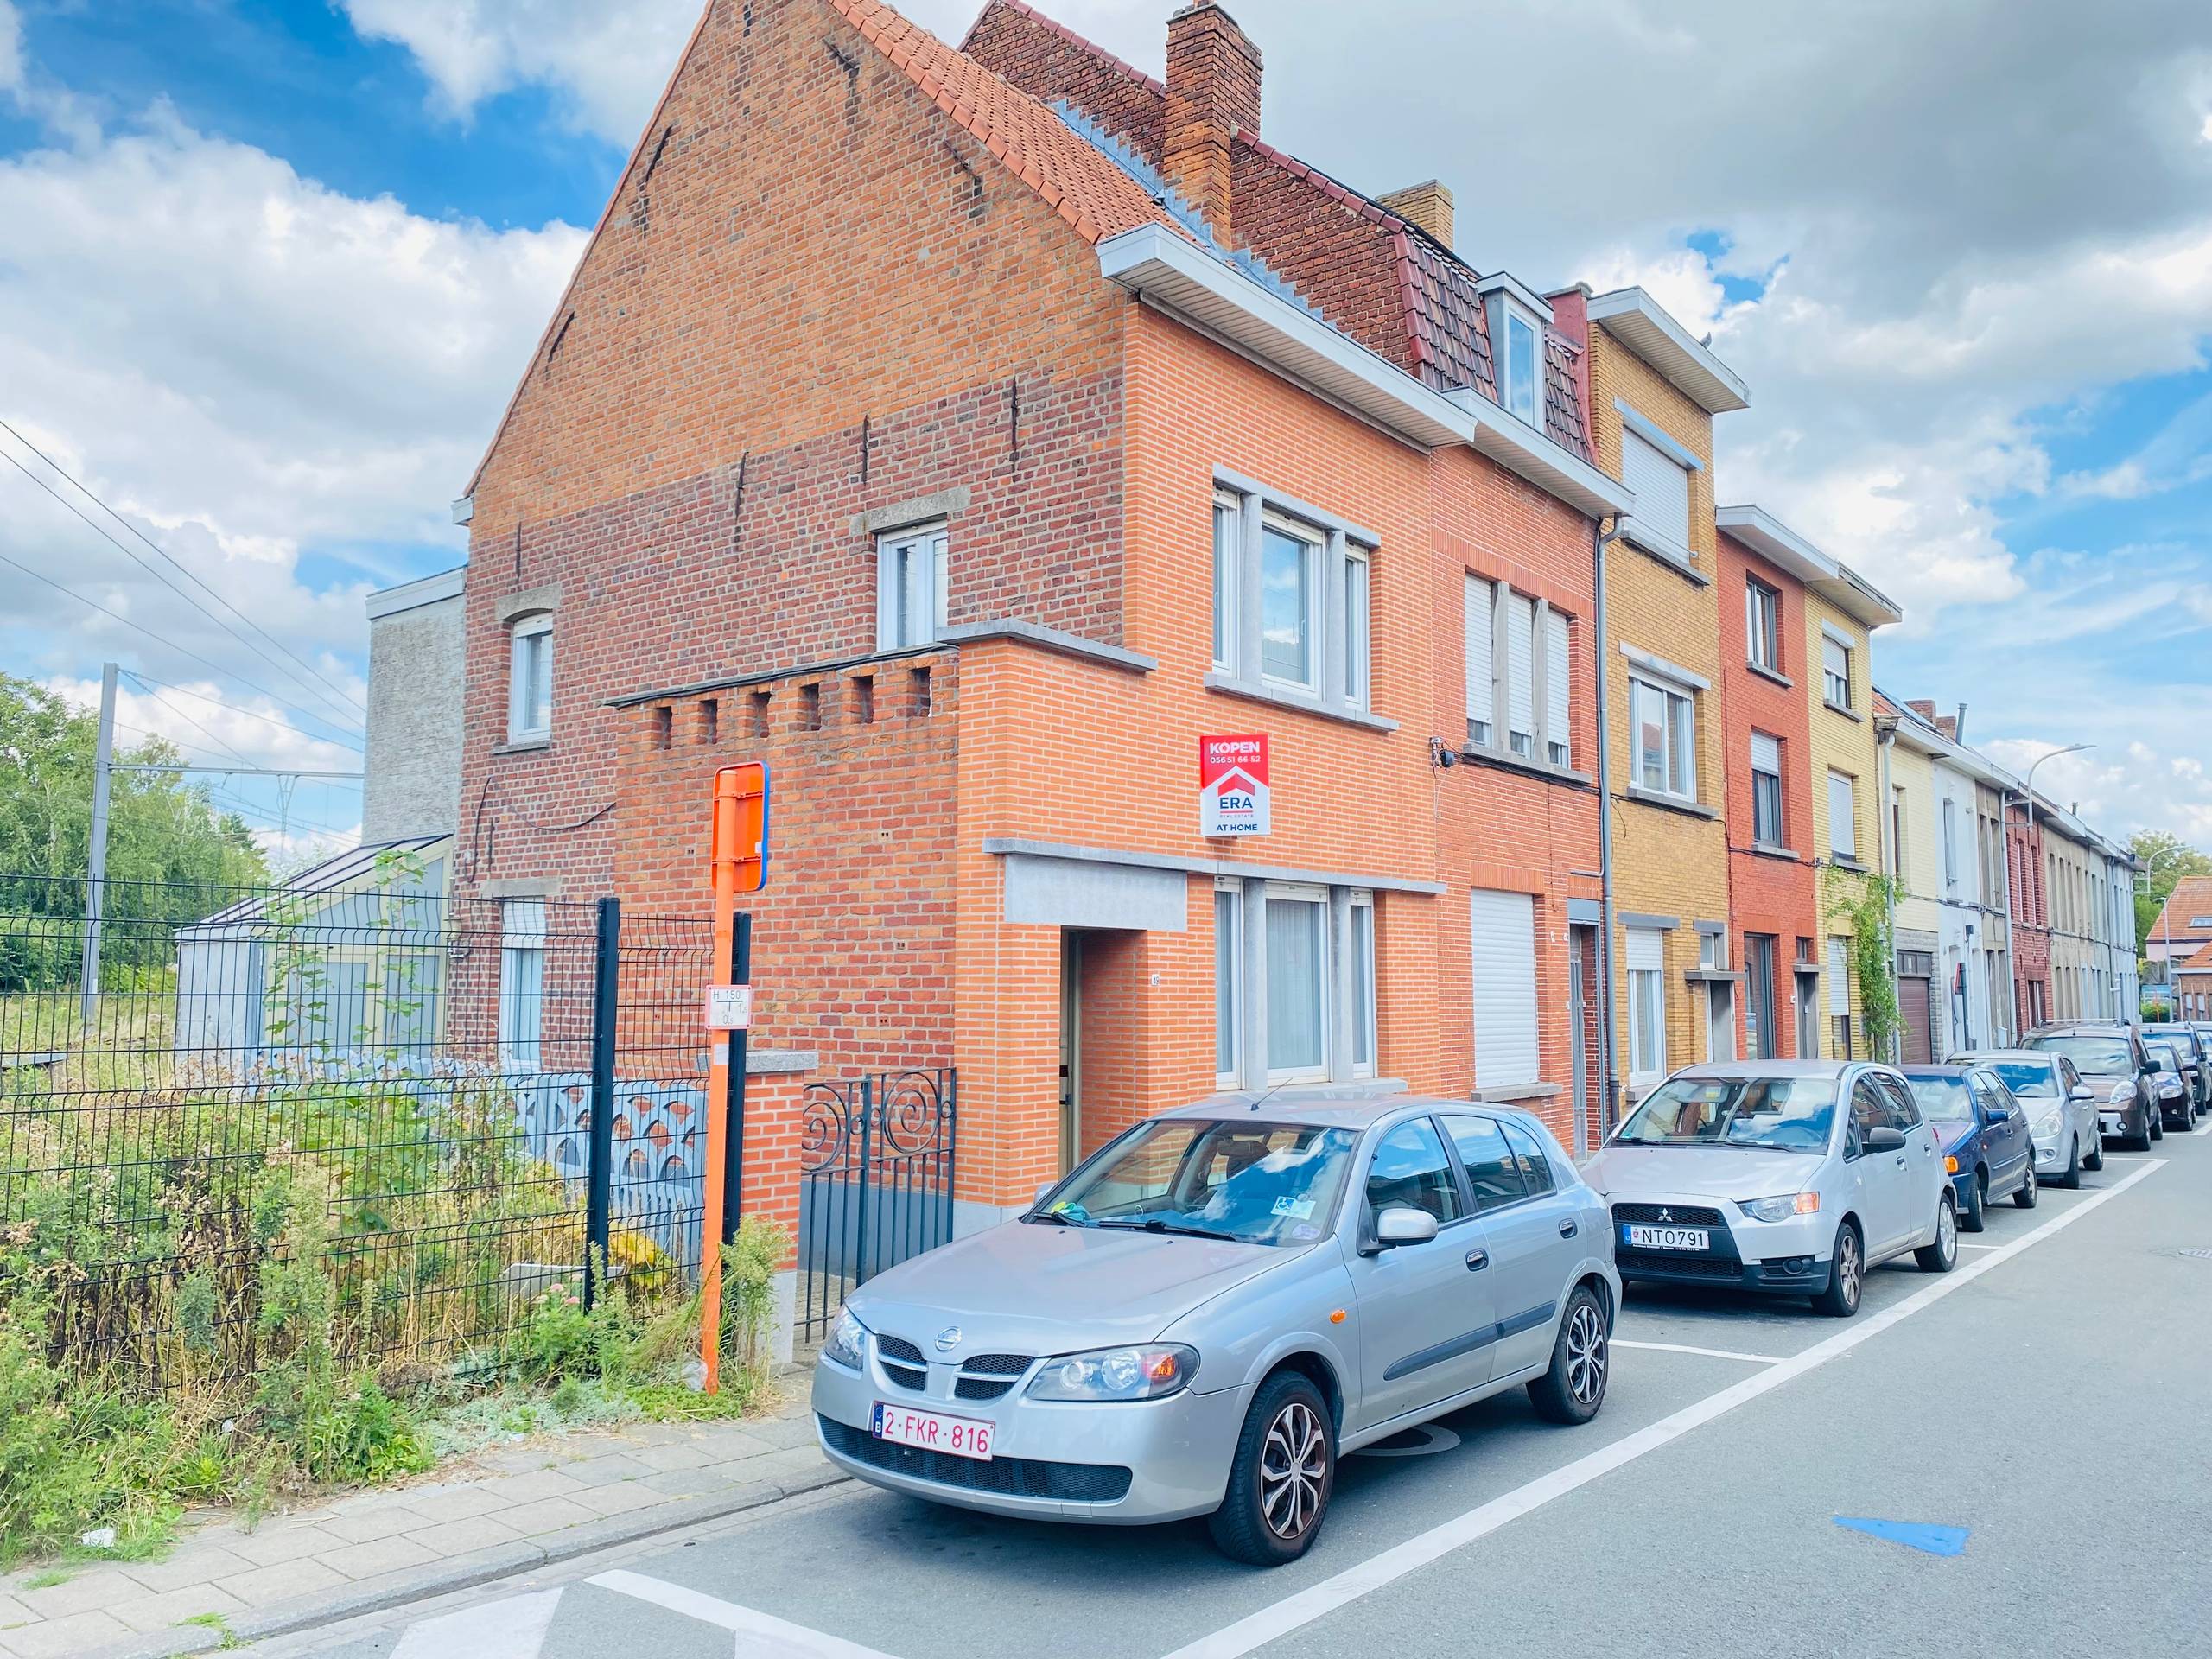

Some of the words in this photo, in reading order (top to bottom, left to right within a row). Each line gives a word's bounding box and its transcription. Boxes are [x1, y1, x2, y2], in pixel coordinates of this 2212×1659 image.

[1210, 741, 1260, 753] KOPEN
[1220, 797, 1253, 809] ERA
[713, 990, 720, 1000] H
[726, 990, 741, 1000] 150
[874, 1421, 881, 1433] B
